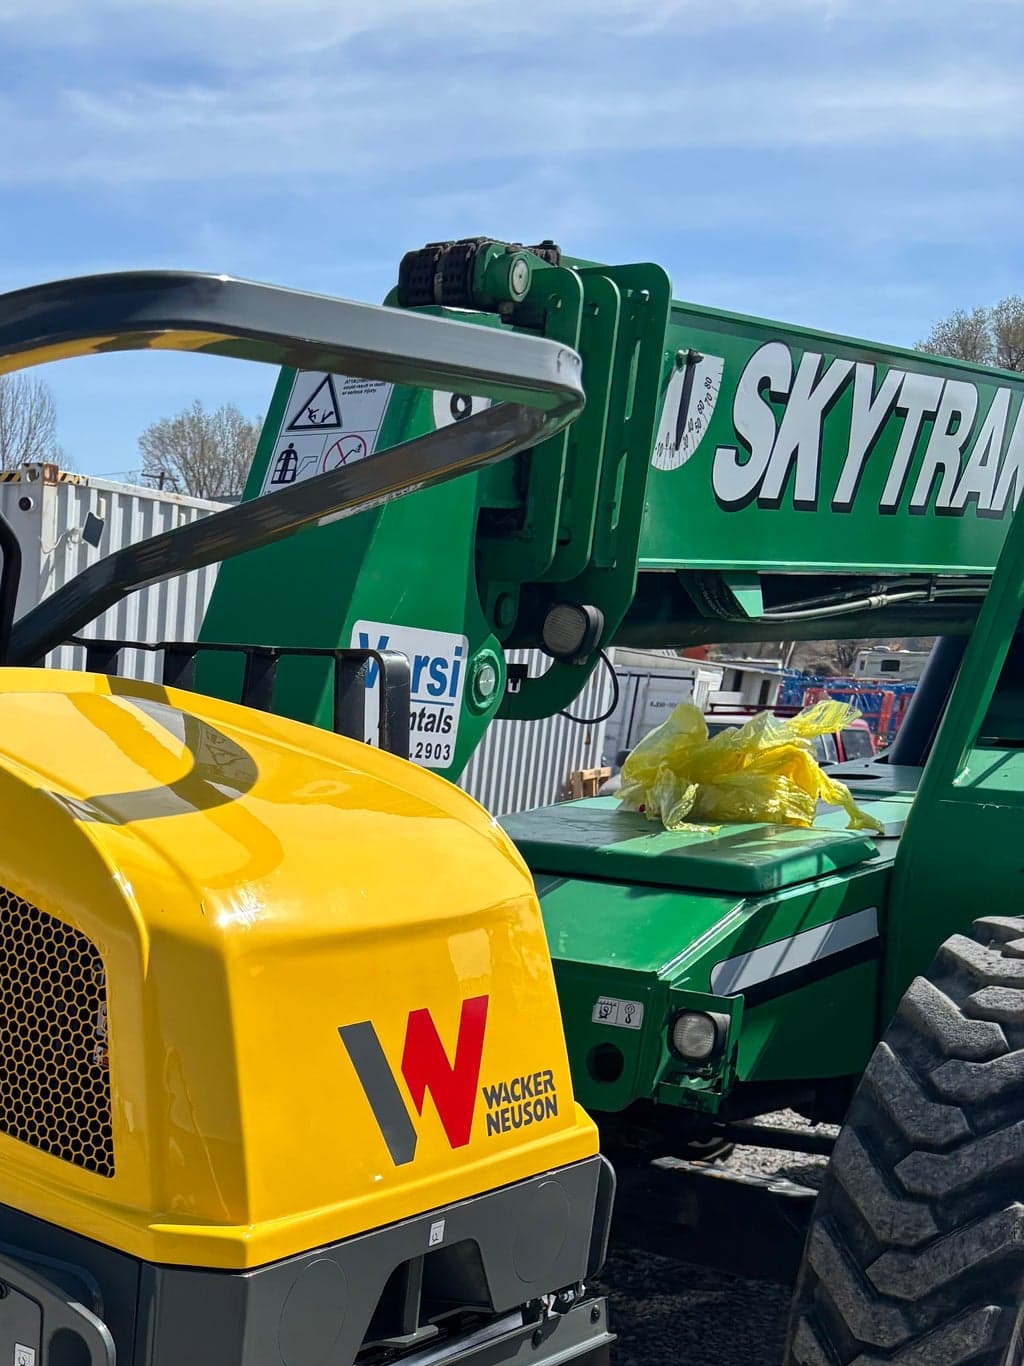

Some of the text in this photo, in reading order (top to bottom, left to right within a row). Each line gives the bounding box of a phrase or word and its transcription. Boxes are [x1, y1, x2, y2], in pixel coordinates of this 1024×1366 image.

[359, 632, 463, 698] Vrsi
[378, 707, 453, 733] ntals
[482, 1069, 556, 1110] WACKER
[485, 1094, 558, 1137] NEUSON
